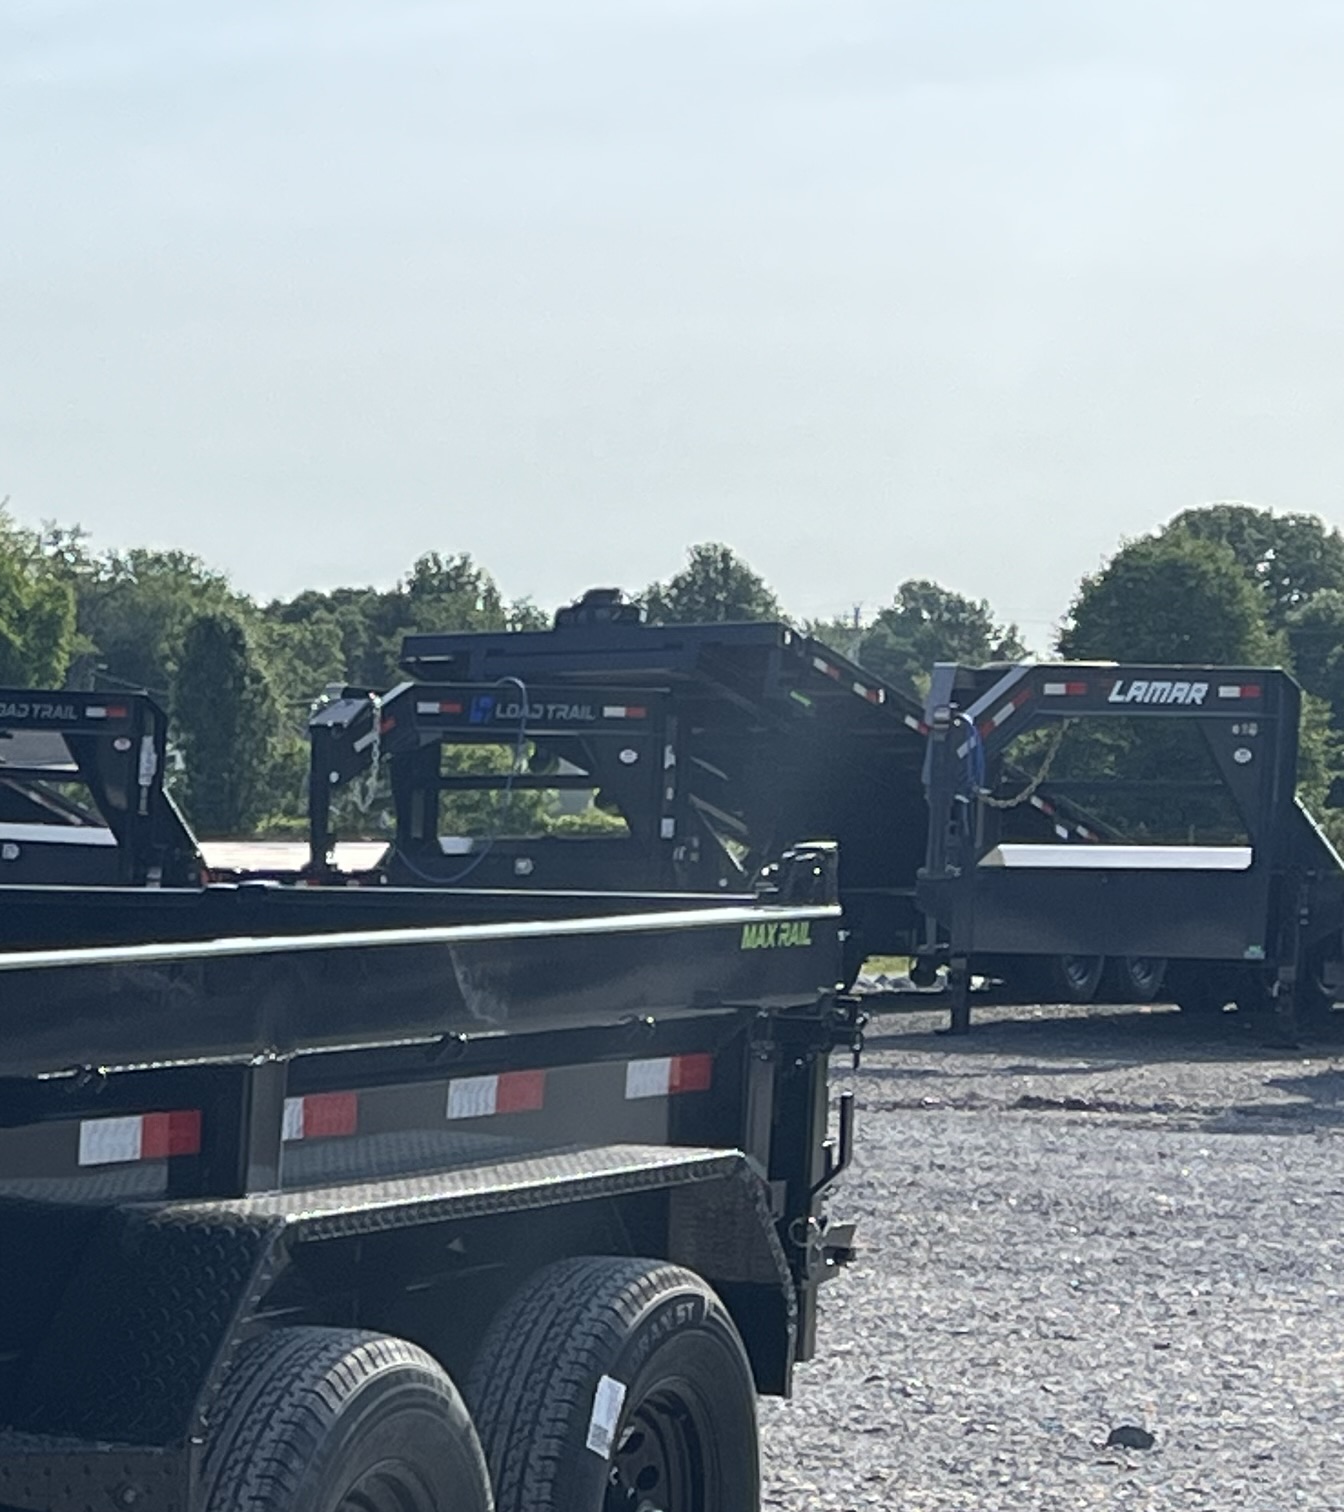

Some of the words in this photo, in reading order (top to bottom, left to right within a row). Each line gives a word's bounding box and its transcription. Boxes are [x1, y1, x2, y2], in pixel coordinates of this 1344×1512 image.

[1108, 679, 1209, 705] LAMAR
[31, 703, 79, 720] TRAIL
[495, 703, 544, 720] LOAD
[546, 704, 596, 721] TRAIL
[740, 922, 779, 950] MAX
[777, 920, 812, 948] RAIL
